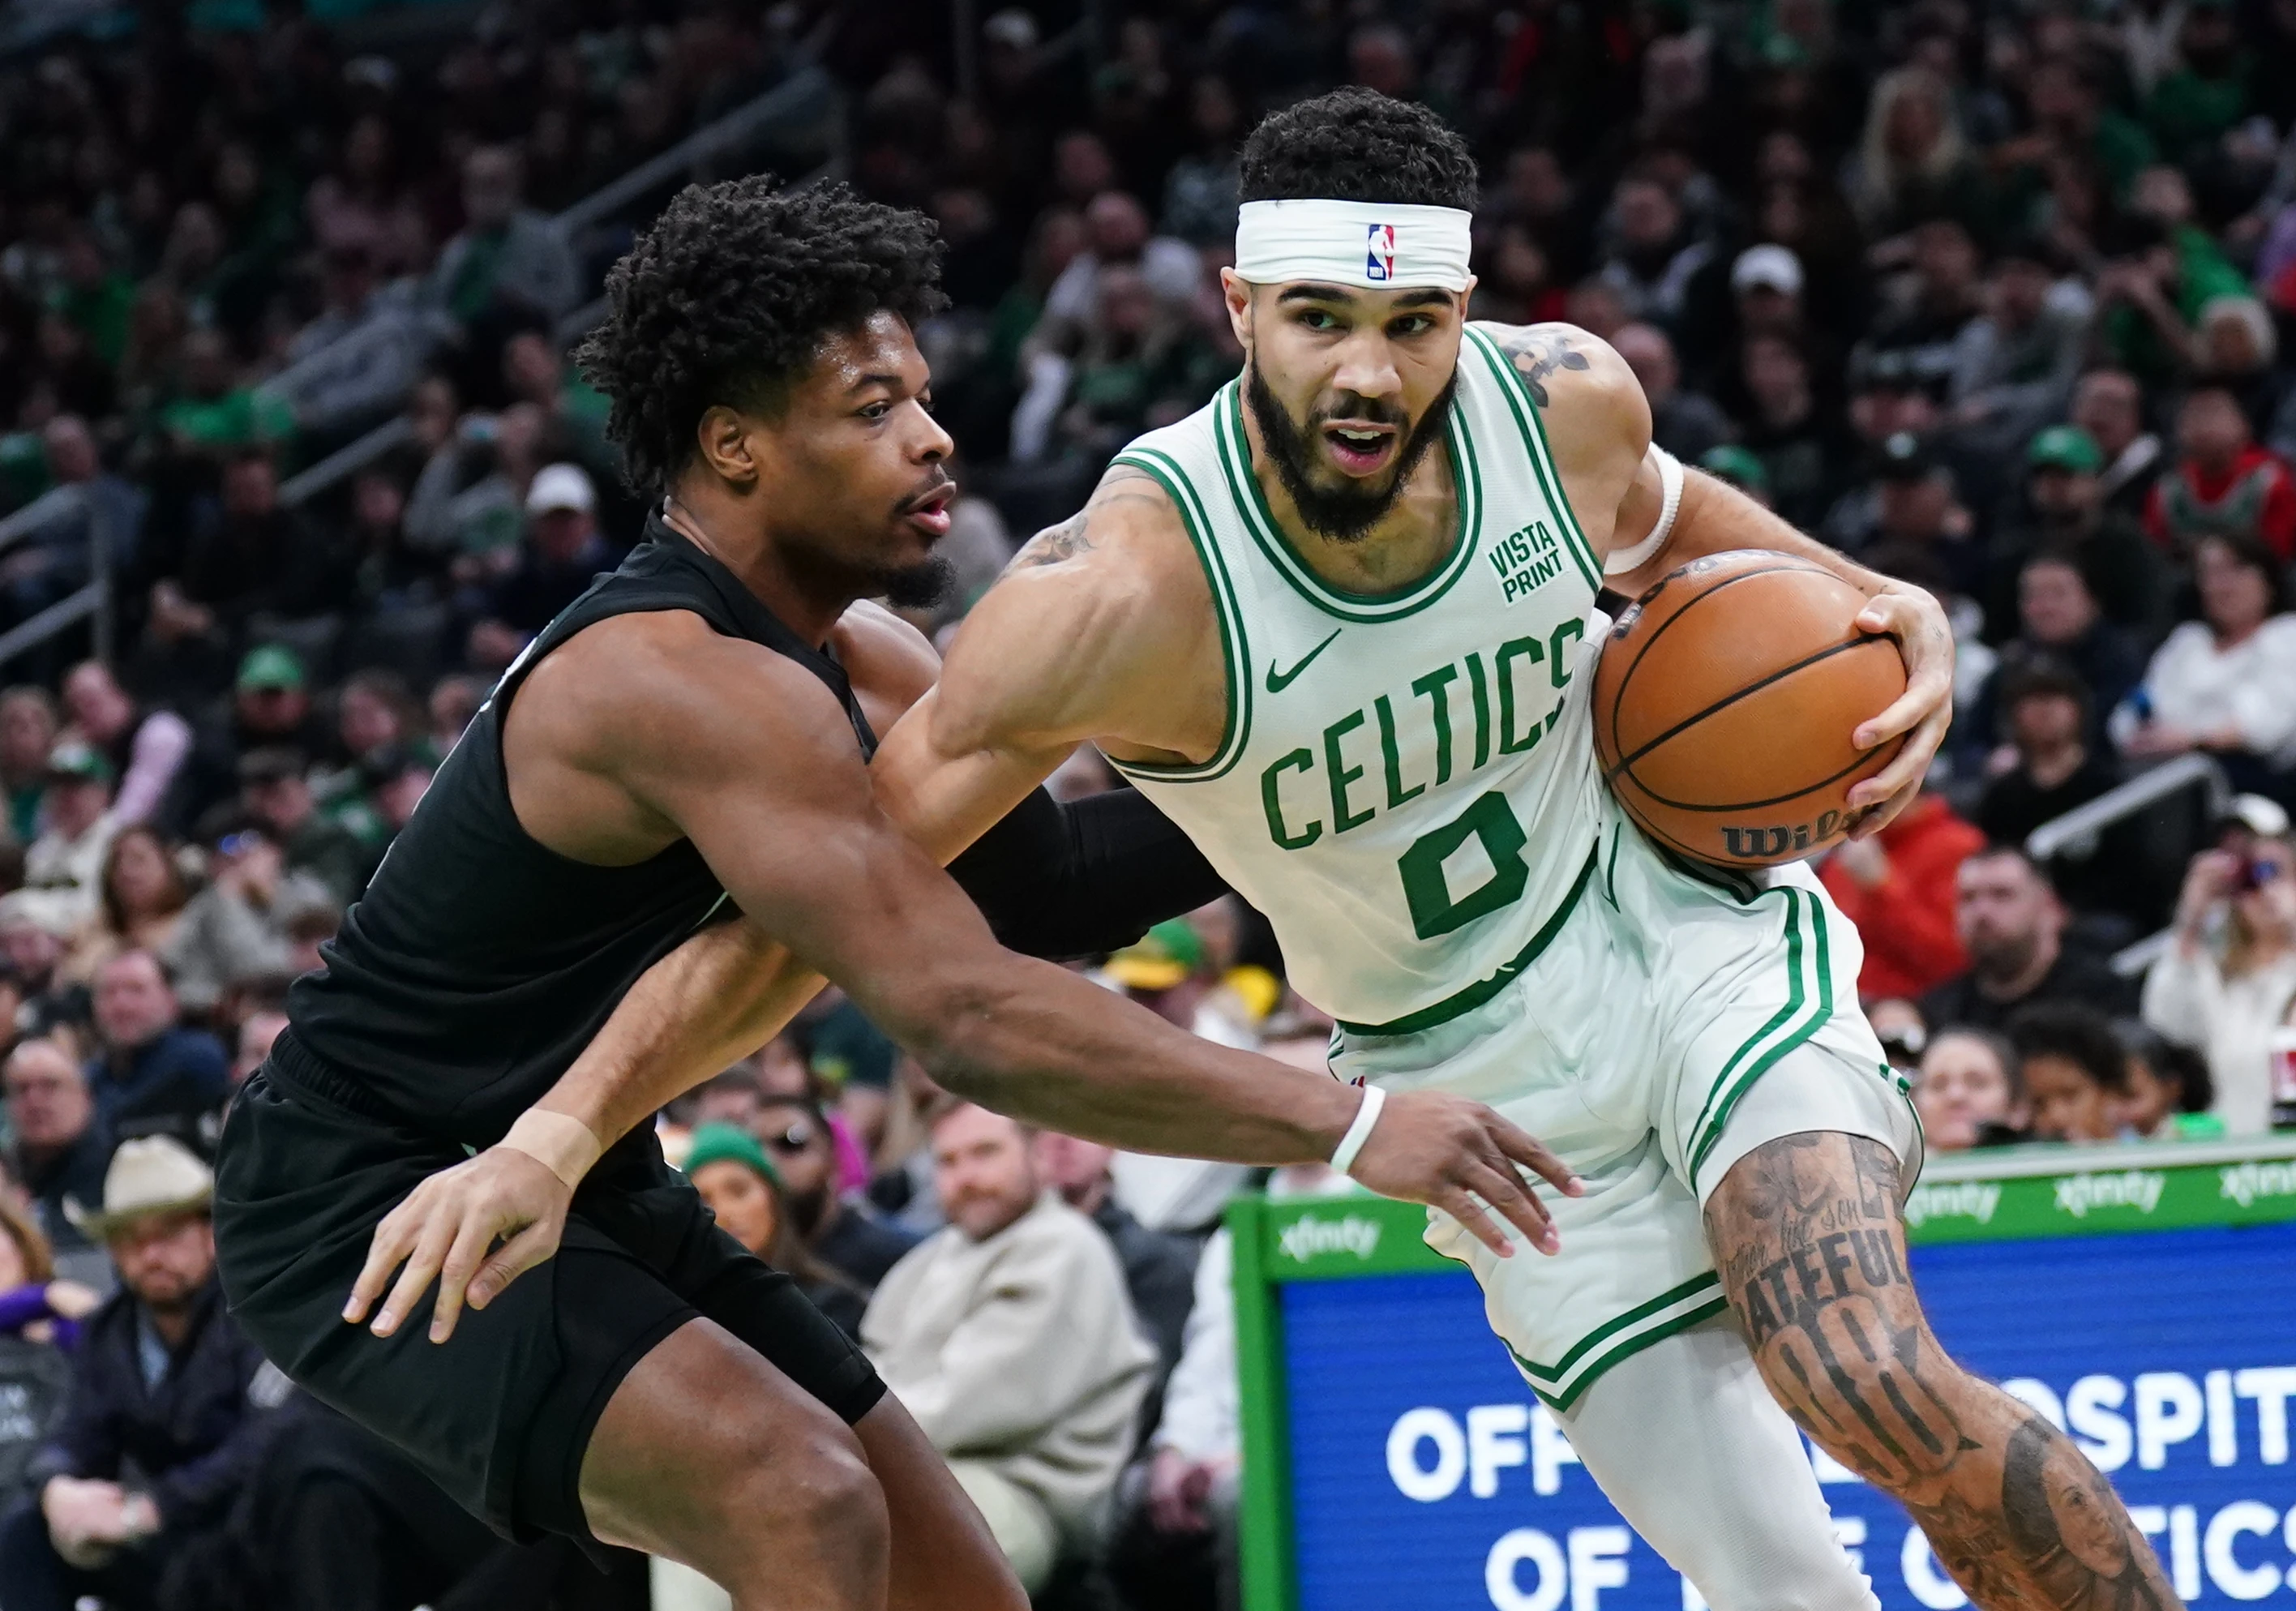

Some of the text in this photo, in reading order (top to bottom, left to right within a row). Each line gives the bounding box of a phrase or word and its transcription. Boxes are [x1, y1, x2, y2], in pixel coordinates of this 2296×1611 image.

[1489, 521, 1556, 578] VISTA
[1502, 548, 1562, 602] PRINT
[1720, 809, 1857, 858] Wil
[1398, 791, 1530, 940] 0
[1905, 1182, 2001, 1228] finity
[1278, 1215, 1381, 1263] xfinity
[1741, 1229, 1907, 1348] ATEFUL
[1484, 1525, 1632, 1611] OF
